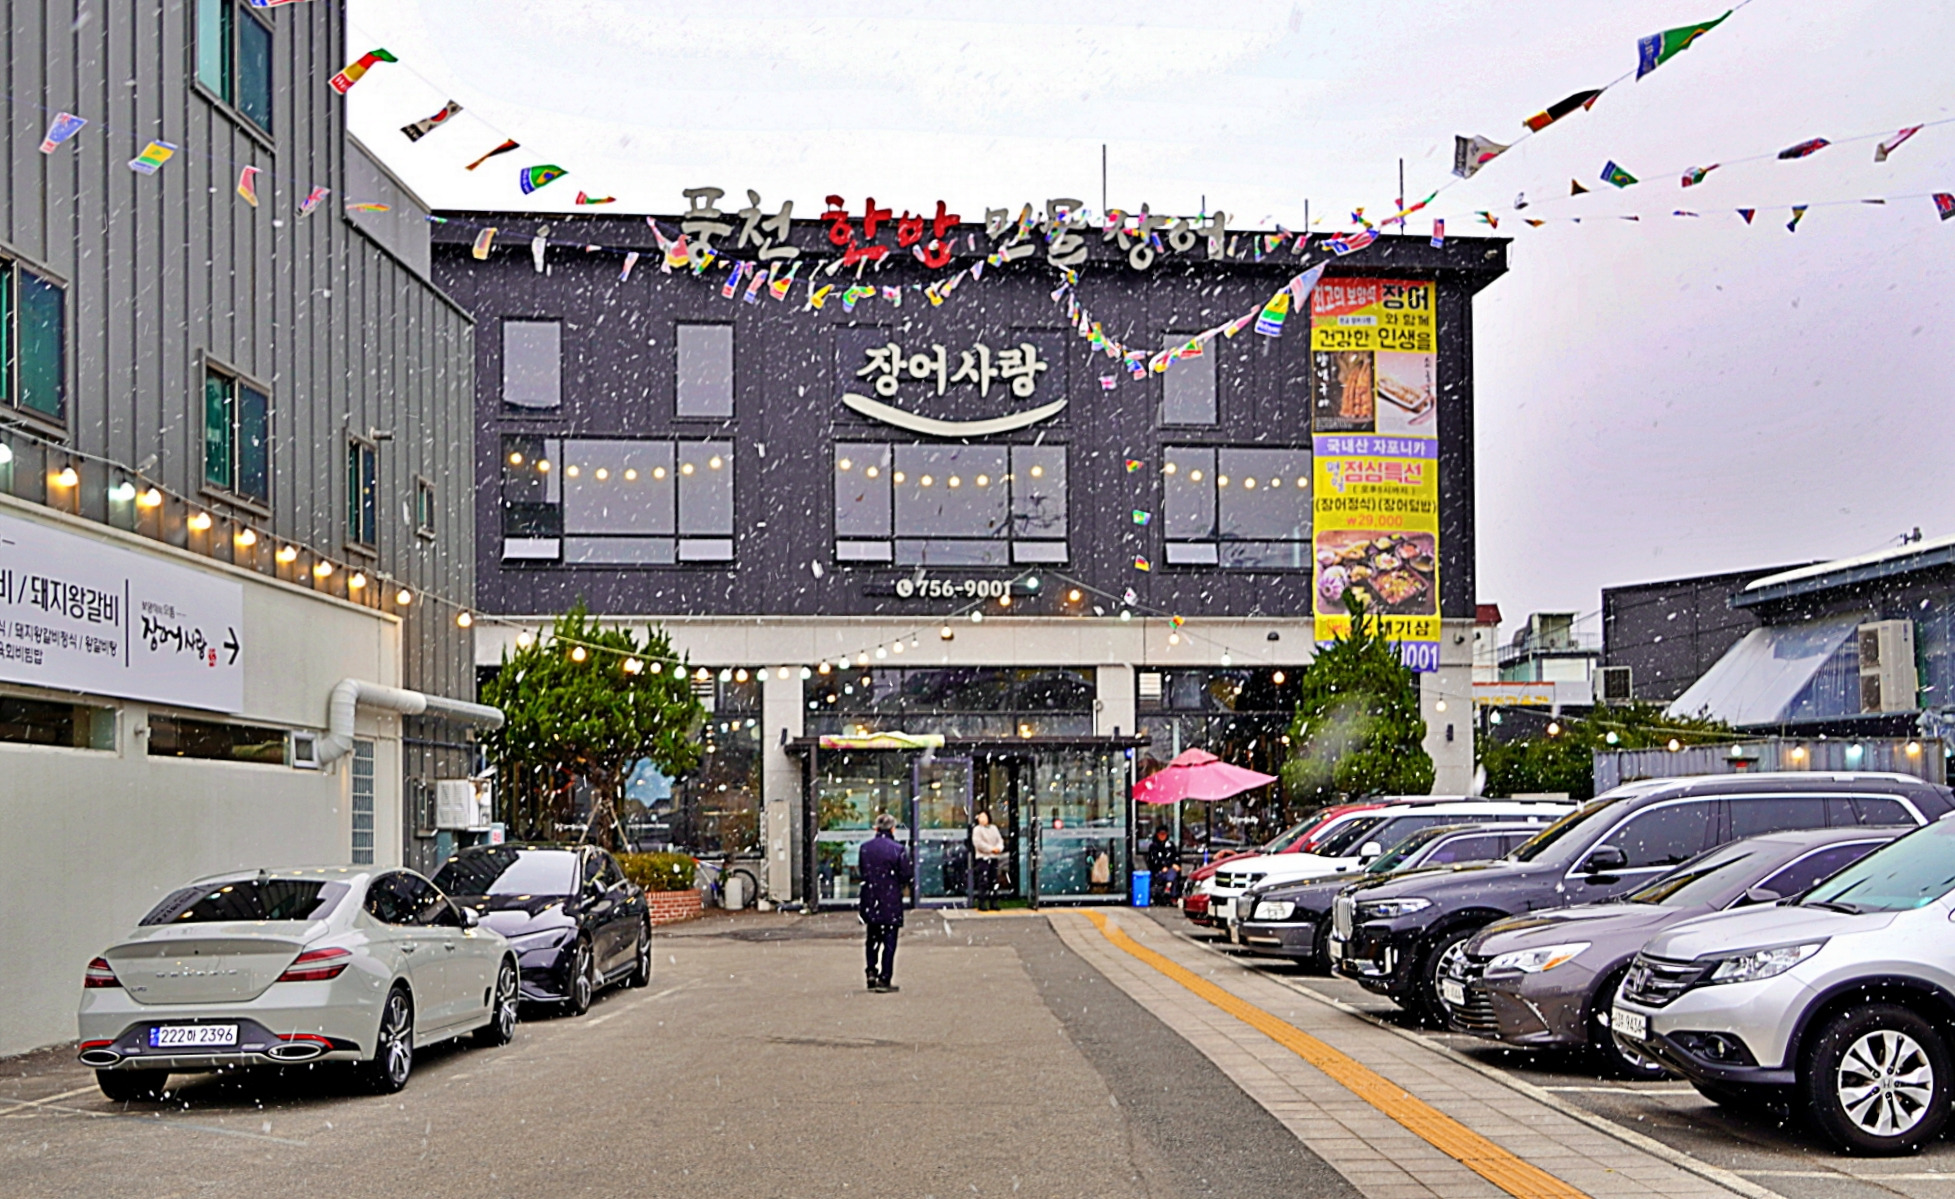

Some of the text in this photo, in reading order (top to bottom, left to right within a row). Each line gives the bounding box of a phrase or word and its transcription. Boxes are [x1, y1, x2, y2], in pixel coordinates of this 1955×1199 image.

[680, 187, 800, 265] 풍천
[820, 195, 960, 269] 한방
[1314, 284, 1345, 313] 최고의
[1382, 284, 1429, 310] 장어
[1319, 328, 1431, 350] 건강한 인생을
[857, 342, 1049, 397] 장어사랑
[1327, 437, 1426, 456] 국내산 자포니카
[1344, 461, 1422, 485] 점심특선
[918, 579, 1011, 598] 756-9001
[141, 614, 208, 660] 장어사랑
[200, 1027, 233, 1042] 2396
